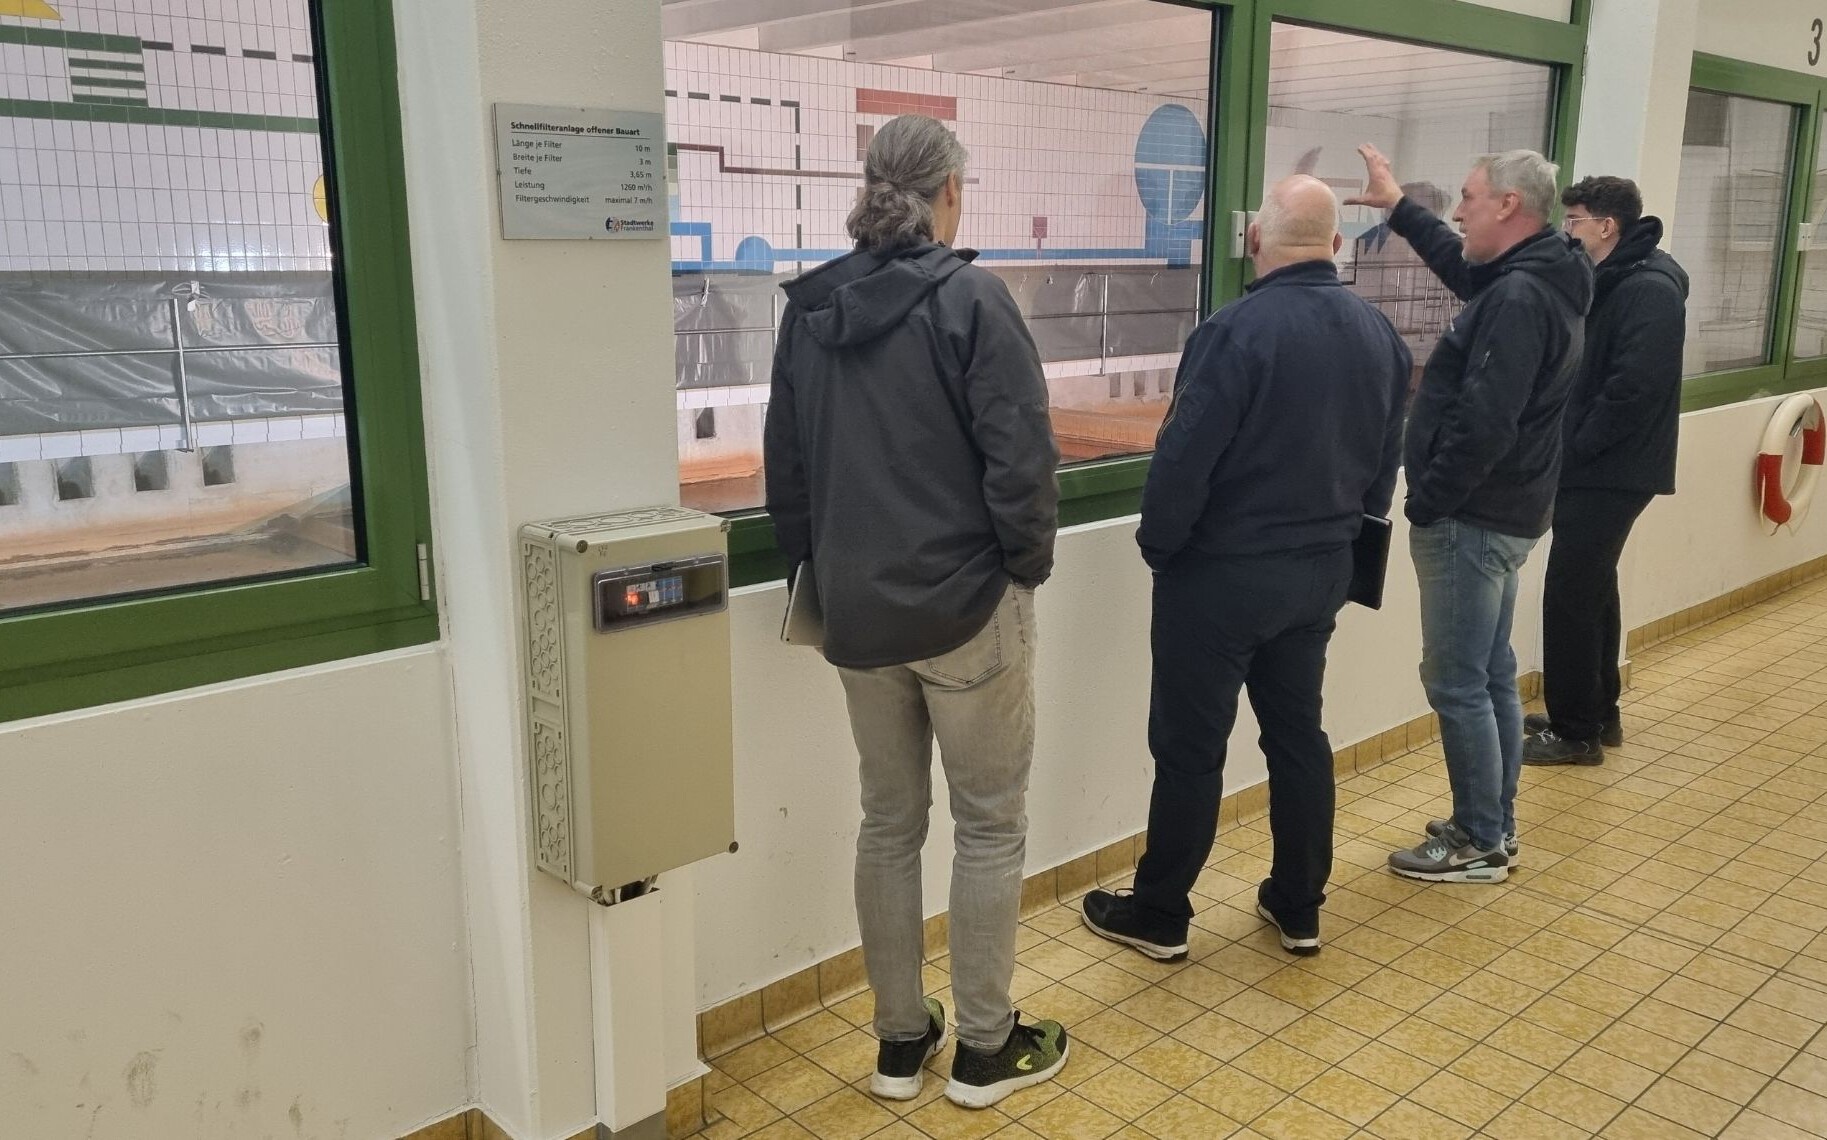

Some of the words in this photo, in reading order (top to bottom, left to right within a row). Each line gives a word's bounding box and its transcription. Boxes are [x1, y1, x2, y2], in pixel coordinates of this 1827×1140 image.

[1807, 18, 1823, 66] 3
[511, 122, 585, 134] Schnellfilteranlage
[586, 126, 614, 135] offener
[616, 128, 640, 136] Bauart
[512, 139, 534, 149] Länge
[536, 141, 542, 149] je
[544, 141, 562, 149] Filter
[513, 154, 535, 162] Breite
[536, 155, 542, 163] je
[544, 154, 562, 162] Filter
[514, 167, 532, 175] Tiefe
[630, 171, 644, 179] 3,65
[515, 181, 545, 190] Leistung
[516, 195, 590, 205] Filtergeschwindigkeit
